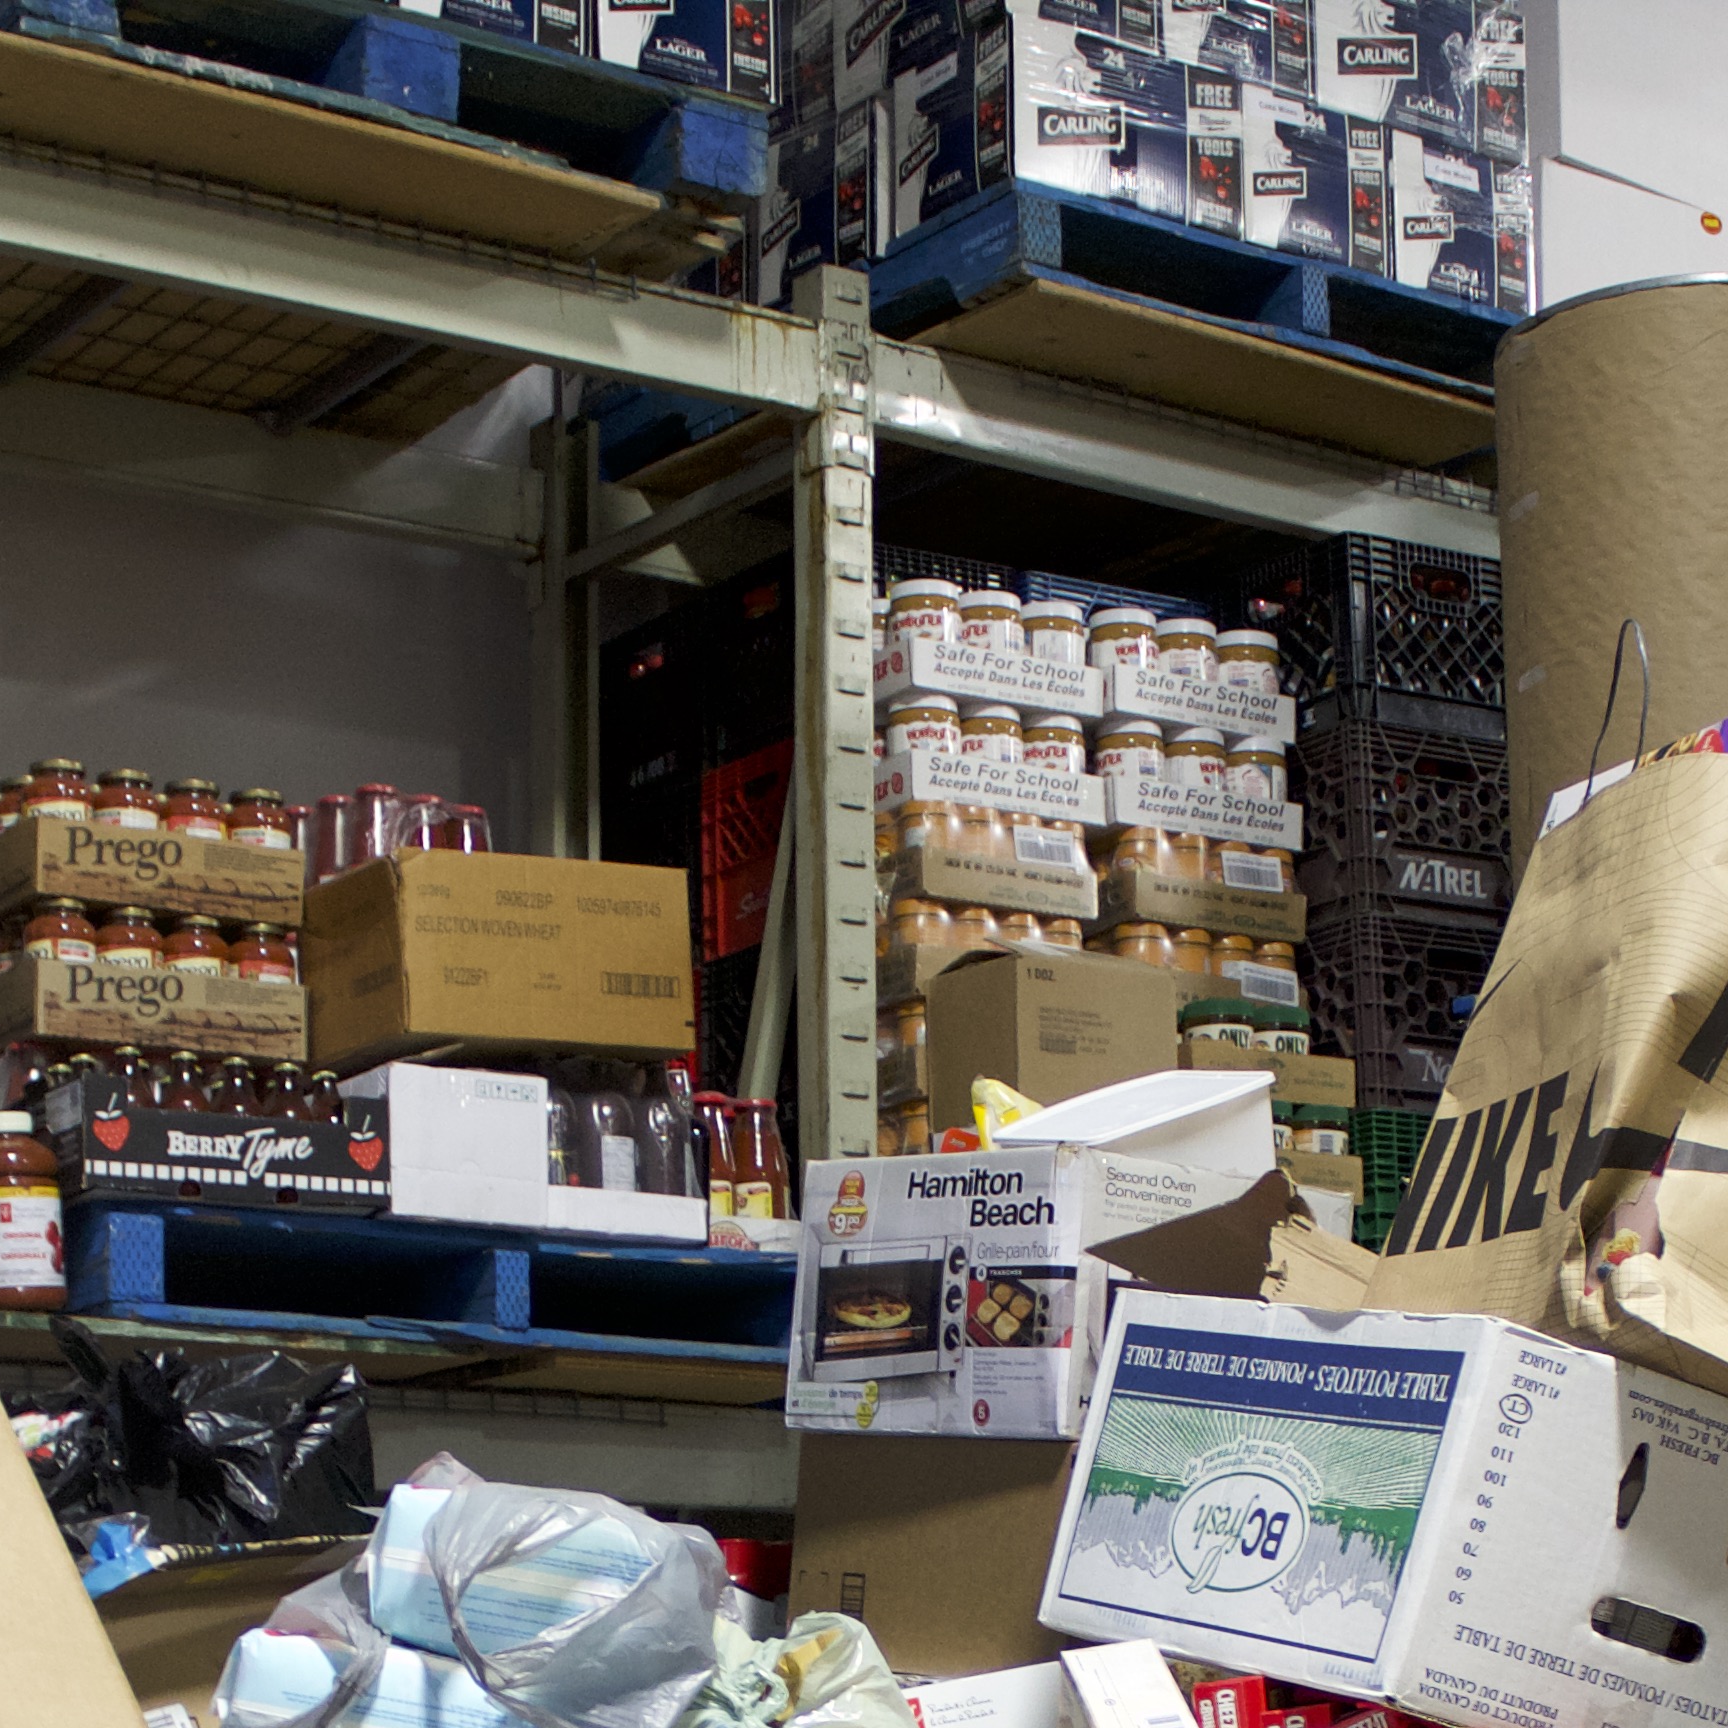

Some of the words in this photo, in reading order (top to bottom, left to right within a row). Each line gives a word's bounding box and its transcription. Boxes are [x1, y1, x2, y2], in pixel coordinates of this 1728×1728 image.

[654, 37, 707, 62] LAGER
[1343, 46, 1411, 66] CARLING
[1196, 83, 1233, 108] FREE
[1405, 95, 1456, 122] LAGER
[1043, 115, 1117, 136] CARLING
[1197, 138, 1234, 158] TOOLS
[1352, 130, 1379, 149] FREE
[1256, 176, 1301, 192] CARLING
[1292, 221, 1333, 241] LAGER
[934, 644, 976, 665] Safe
[981, 652, 1015, 673] For
[1020, 657, 1086, 682] School
[988, 671, 1019, 688] Dans
[1022, 676, 1043, 690] Les
[1136, 670, 1174, 690] Safe
[1180, 679, 1213, 697] For
[1215, 685, 1278, 711] School
[1186, 696, 1215, 712] Dans
[929, 756, 970, 776] Safe
[976, 763, 1010, 783] For
[1015, 768, 1079, 793] School
[1138, 781, 1178, 802] Safe
[1185, 789, 1219, 809] For
[1222, 794, 1285, 818] School
[1190, 807, 1220, 823] Dans
[1223, 811, 1243, 826] Les
[65, 826, 183, 881] Prego
[1398, 858, 1487, 900] NATREL
[65, 964, 183, 1017] Prego
[167, 1130, 245, 1161] BERRY
[243, 1127, 313, 1179] Tyme
[908, 1169, 1023, 1200] Hamilton
[1106, 1166, 1158, 1188] Second
[1161, 1174, 1196, 1193] Oven
[1105, 1182, 1193, 1208] Convenience
[970, 1196, 1055, 1228] Beach
[1124, 1344, 1165, 1368] TABLE
[1186, 1352, 1226, 1377] TERRE
[1247, 1357, 1309, 1384] POMMES
[1313, 1364, 1398, 1399] POTATOES
[1400, 1371, 1451, 1402] TABLE
[1454, 1623, 1501, 1655] TABLE
[1529, 1647, 1576, 1679] TERRE
[1601, 1671, 1665, 1707] POMMES
